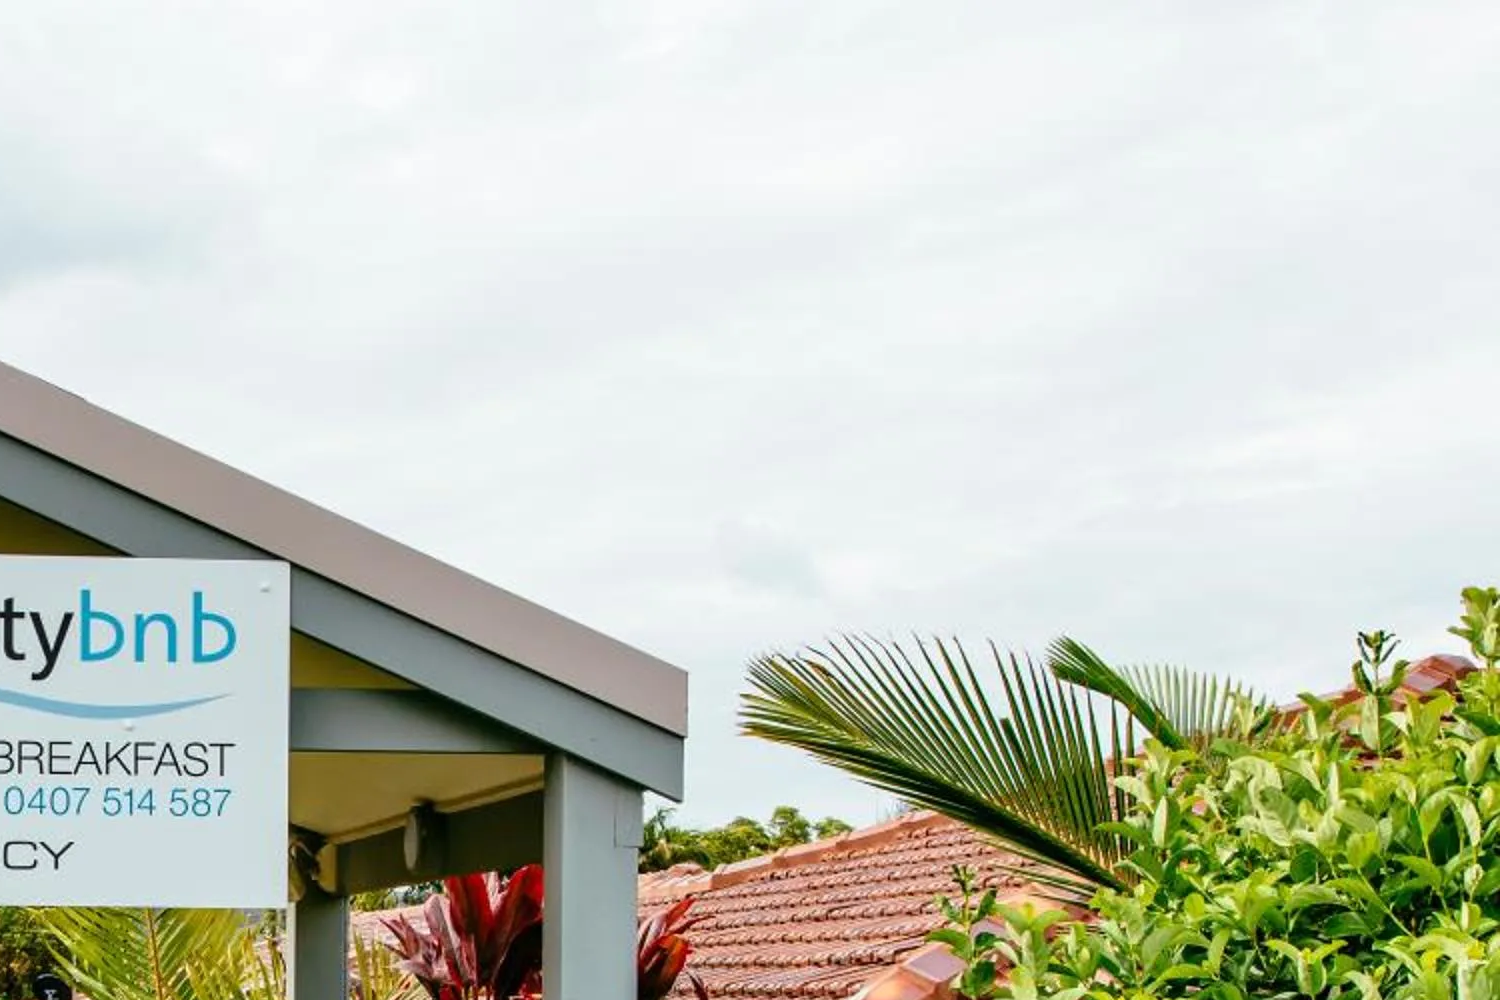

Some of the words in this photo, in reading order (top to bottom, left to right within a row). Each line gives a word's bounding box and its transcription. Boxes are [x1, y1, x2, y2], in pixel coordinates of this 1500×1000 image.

[4, 785, 91, 815] 0407
[102, 788, 156, 816] 514
[168, 788, 232, 817] 587
